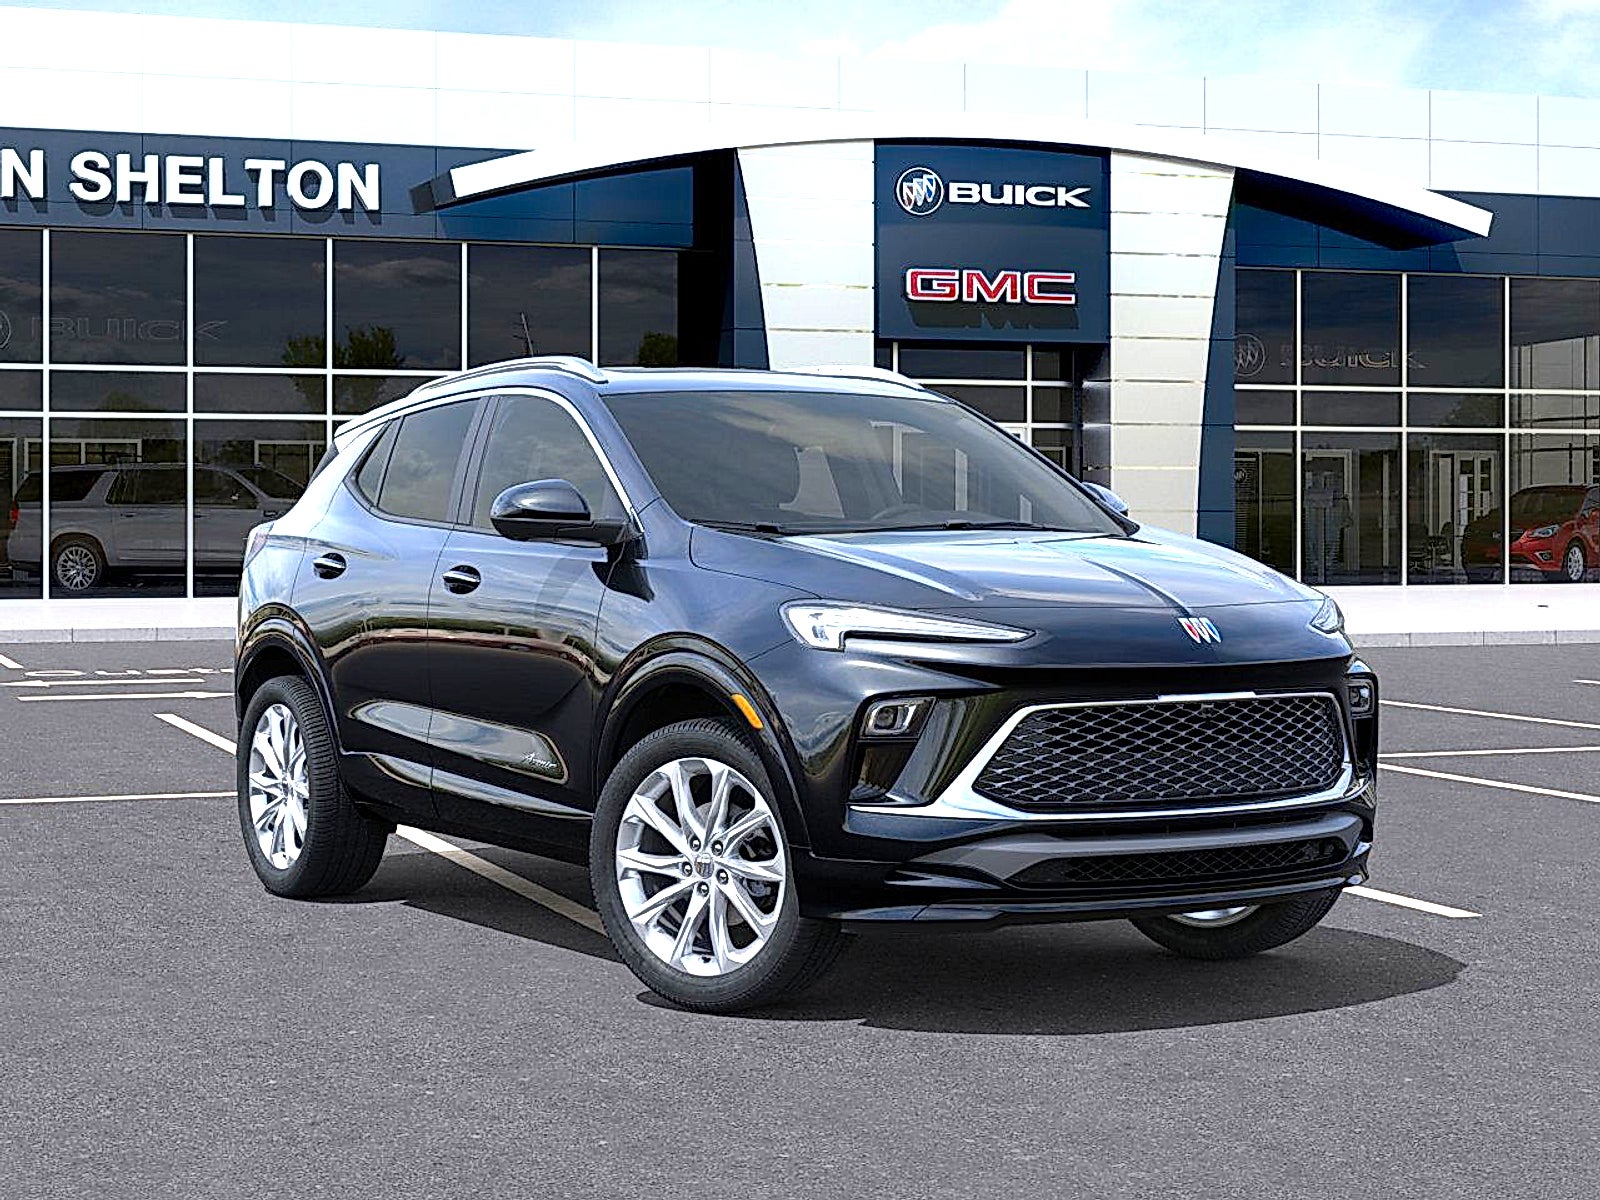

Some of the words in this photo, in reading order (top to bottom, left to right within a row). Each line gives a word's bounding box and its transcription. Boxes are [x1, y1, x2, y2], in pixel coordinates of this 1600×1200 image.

[69, 150, 380, 211] SHELTON
[948, 182, 1091, 208] BUICK
[906, 268, 1076, 304] GMC
